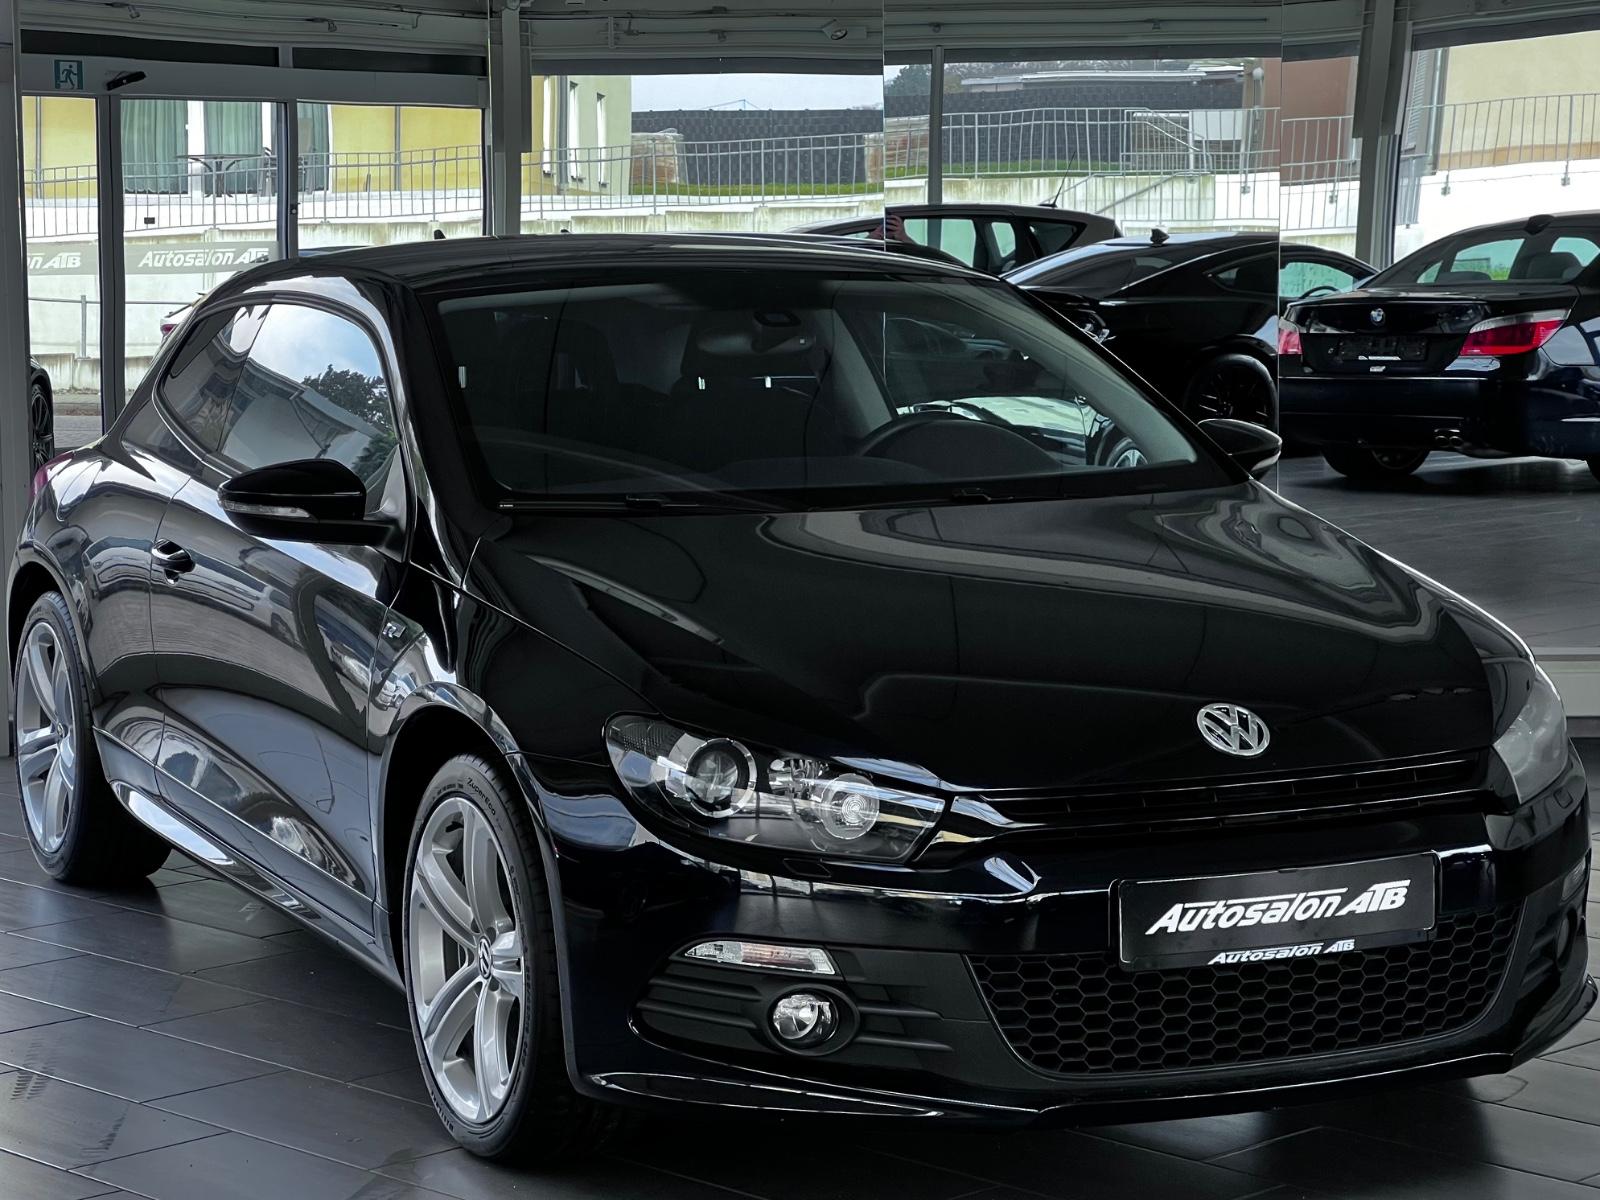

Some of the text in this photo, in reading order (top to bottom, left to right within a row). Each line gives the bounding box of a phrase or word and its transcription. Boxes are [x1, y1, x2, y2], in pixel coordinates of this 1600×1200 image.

[42, 253, 81, 269] ATB
[138, 248, 236, 267] Autosalon
[1145, 879, 1411, 935] Autosalon ATB
[1208, 938, 1355, 965] Autosalon ATB
